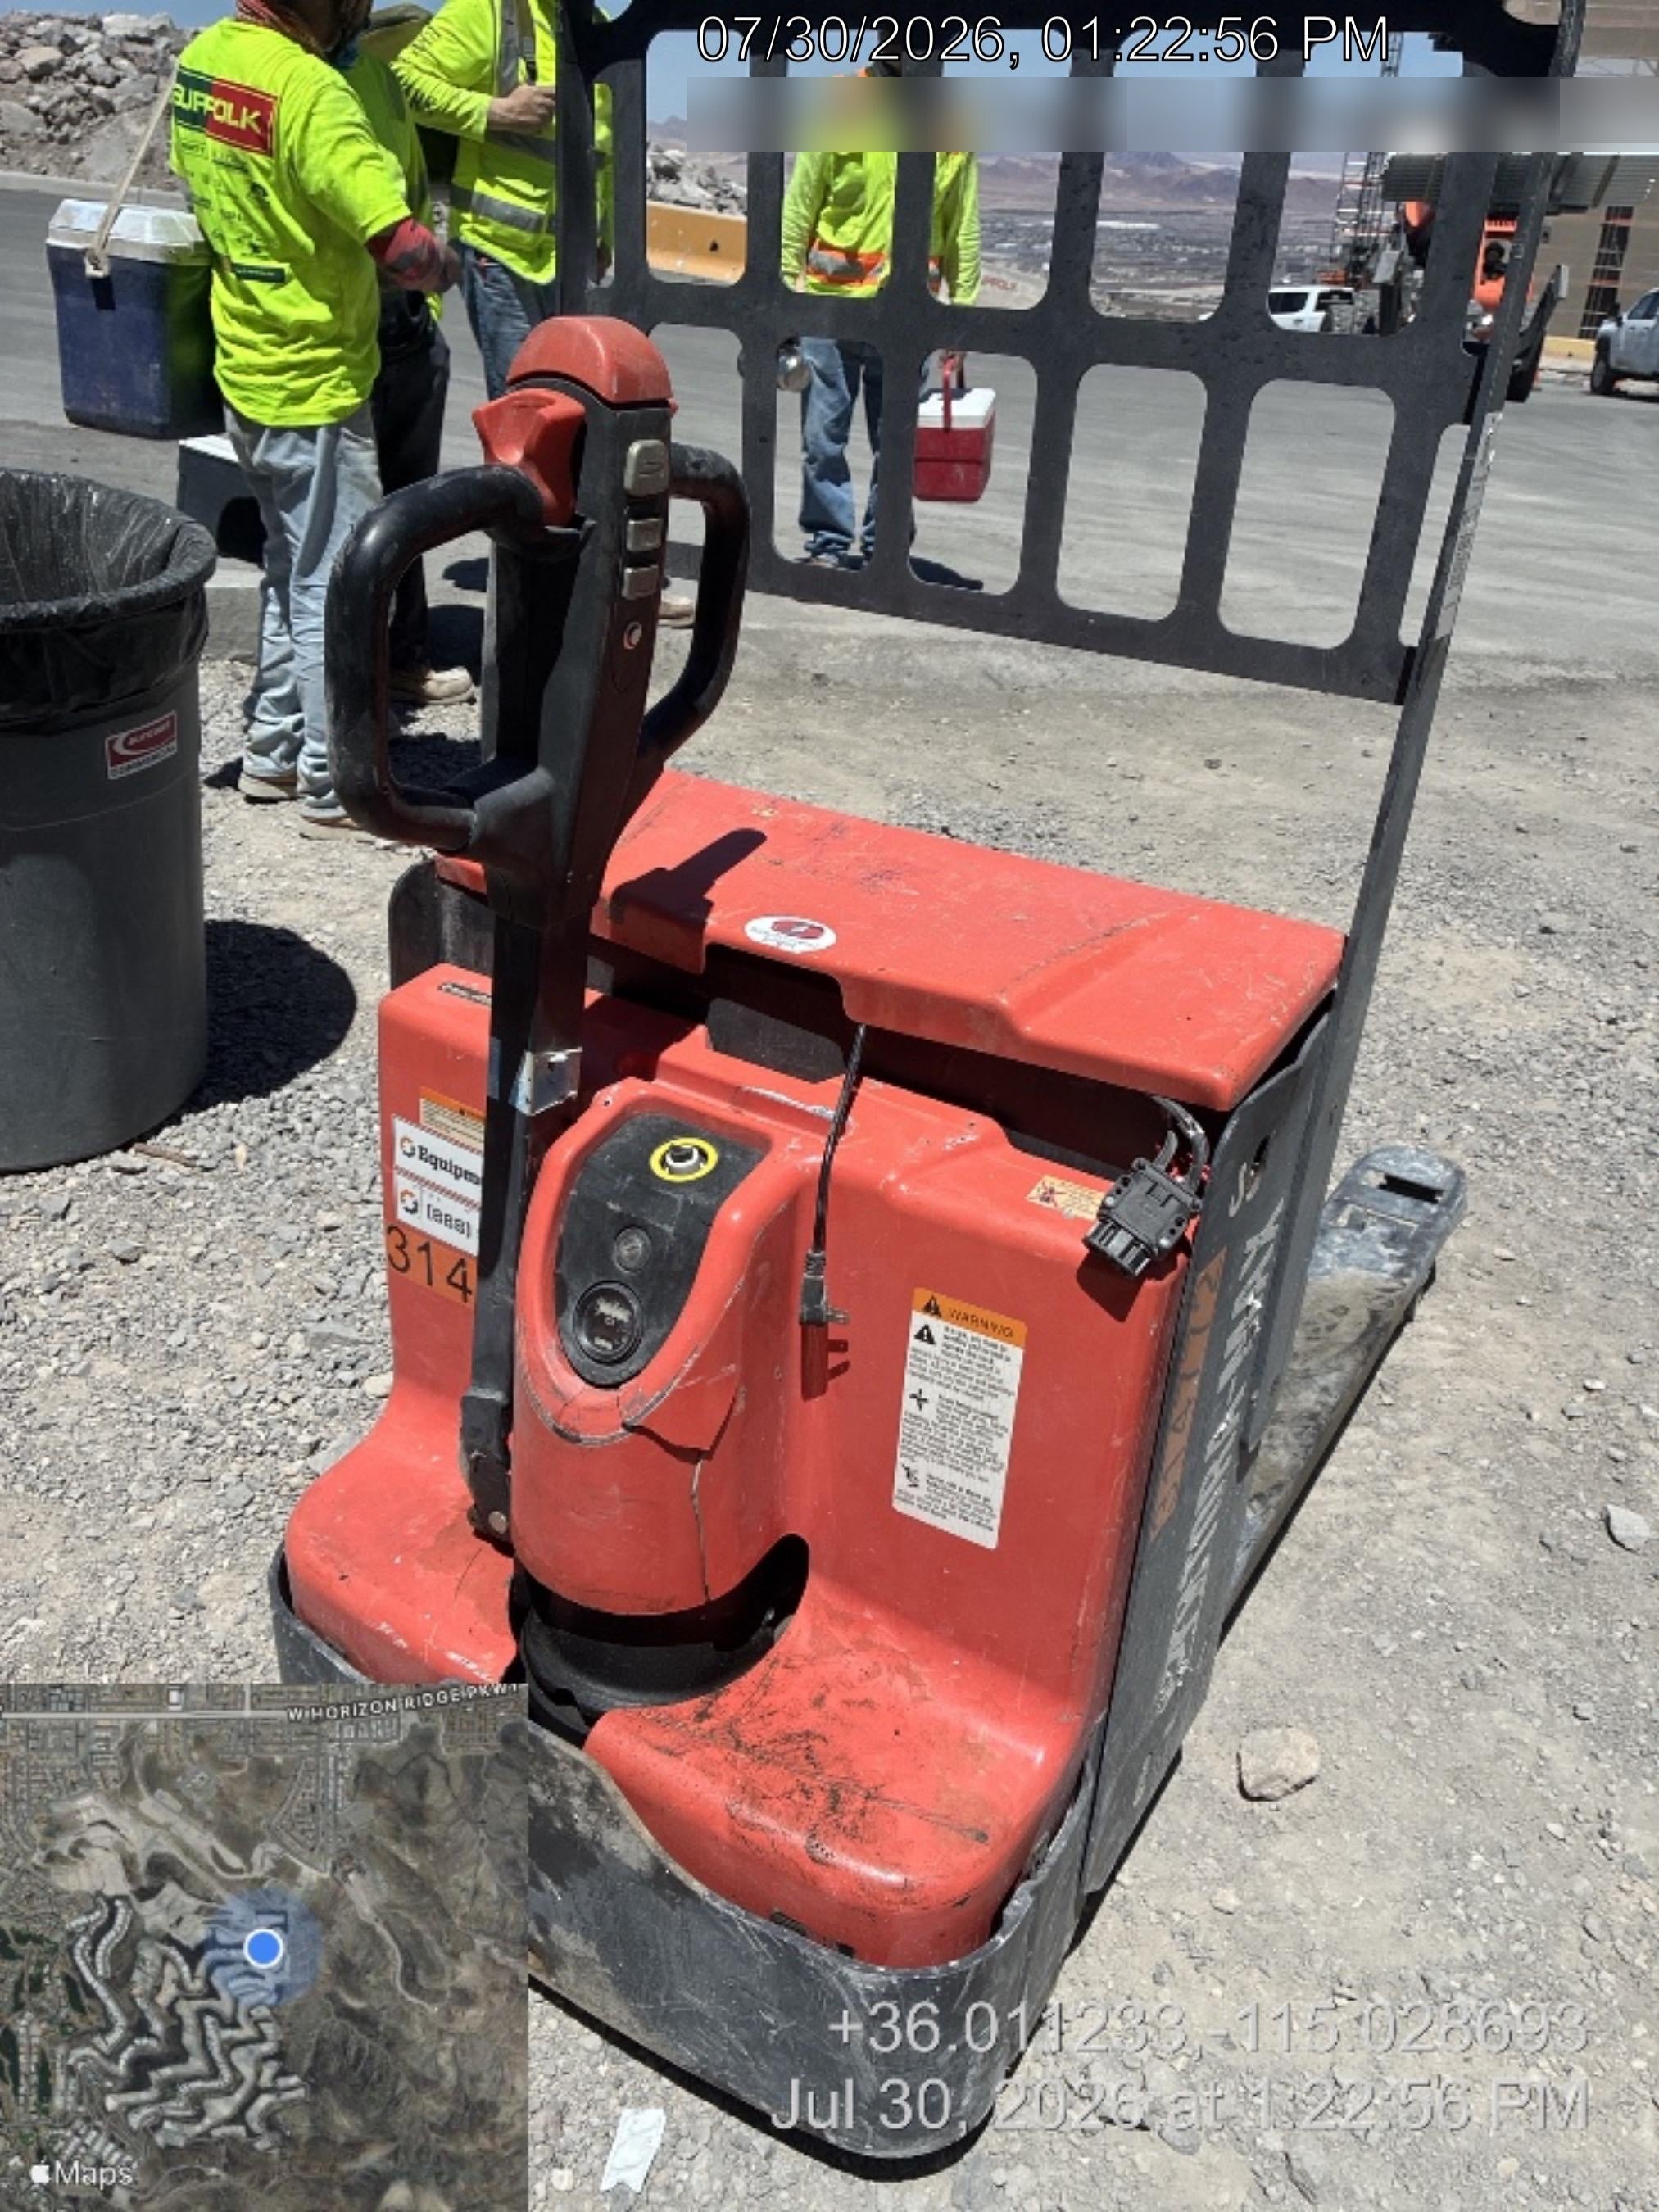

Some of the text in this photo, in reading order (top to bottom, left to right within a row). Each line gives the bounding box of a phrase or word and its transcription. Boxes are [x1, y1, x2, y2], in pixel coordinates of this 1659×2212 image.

[171, 83, 263, 135] SUFFOLK
[387, 1224, 473, 1303] 314
[949, 1307, 1015, 1338] WARNING
